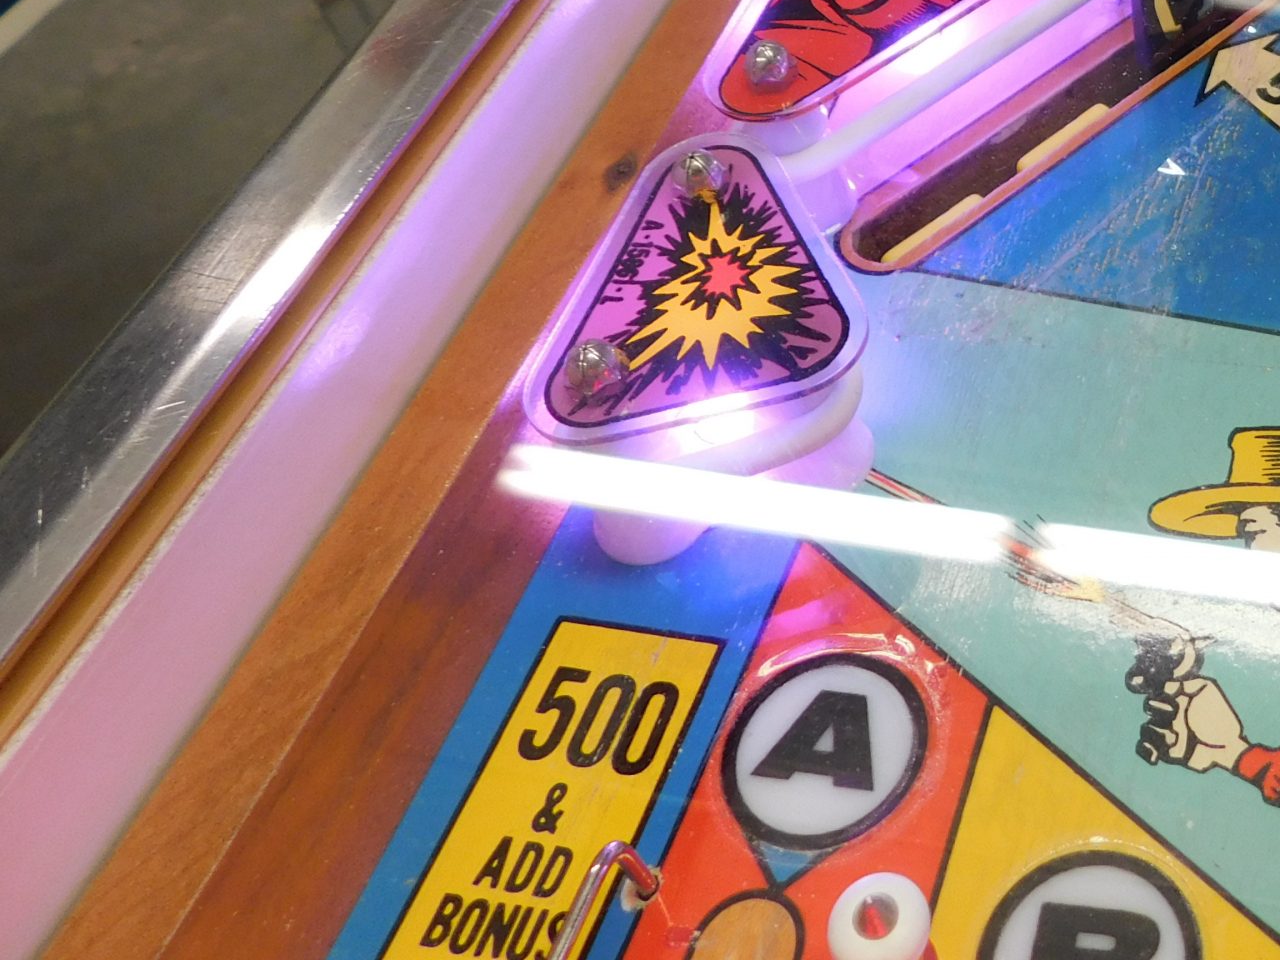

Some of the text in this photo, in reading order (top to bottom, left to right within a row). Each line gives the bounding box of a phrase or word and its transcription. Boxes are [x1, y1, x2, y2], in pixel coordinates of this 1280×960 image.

[518, 666, 680, 776] 500
[750, 689, 873, 792] A
[532, 783, 568, 834] &
[472, 836, 574, 898] ADD
